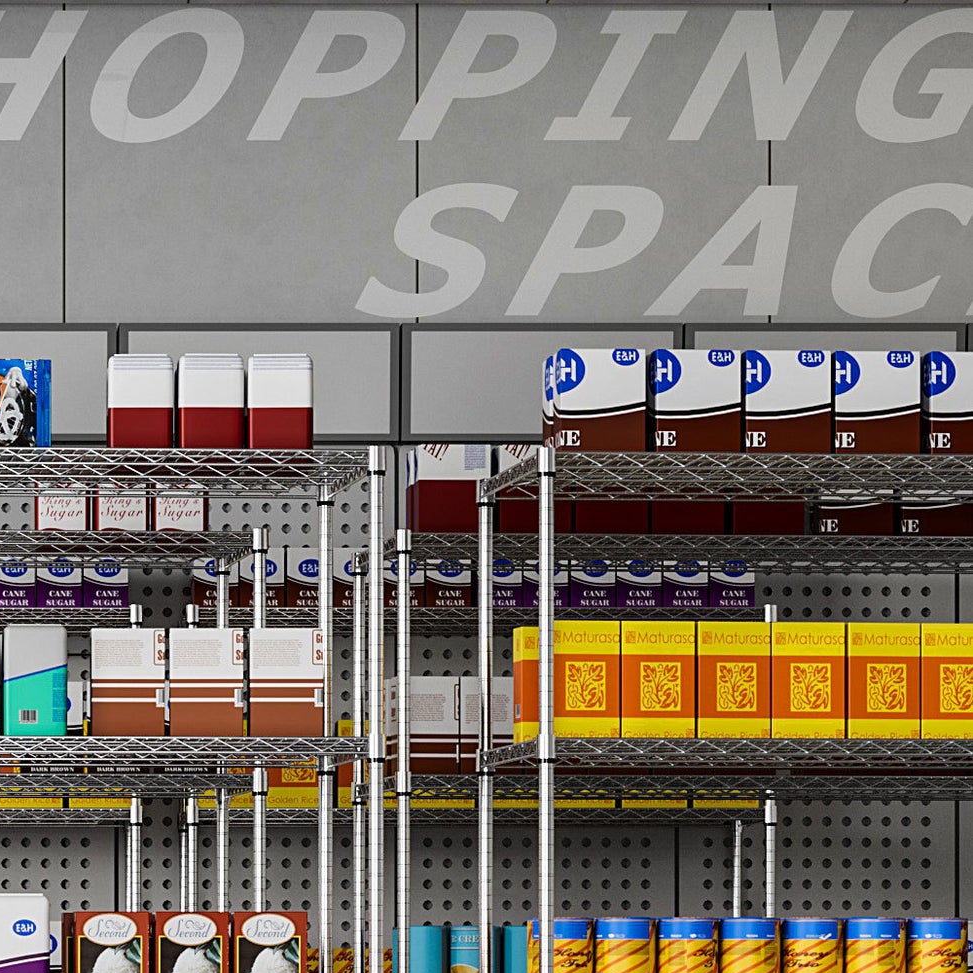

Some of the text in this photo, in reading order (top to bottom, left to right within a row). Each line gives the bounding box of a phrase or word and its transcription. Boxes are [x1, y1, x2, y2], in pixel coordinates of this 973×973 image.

[355, 182, 973, 318] SPAC
[616, 351, 636, 361] E&H
[712, 352, 732, 362] E&H
[801, 352, 822, 363] E&H
[890, 353, 911, 363] E&H
[41, 506, 83, 521] Sugar
[101, 506, 143, 521] Sugar
[158, 506, 200, 521] Sugar
[16, 924, 34, 932] E&H
[88, 919, 131, 938] Second
[168, 919, 211, 938] Second
[246, 919, 290, 938] Second
